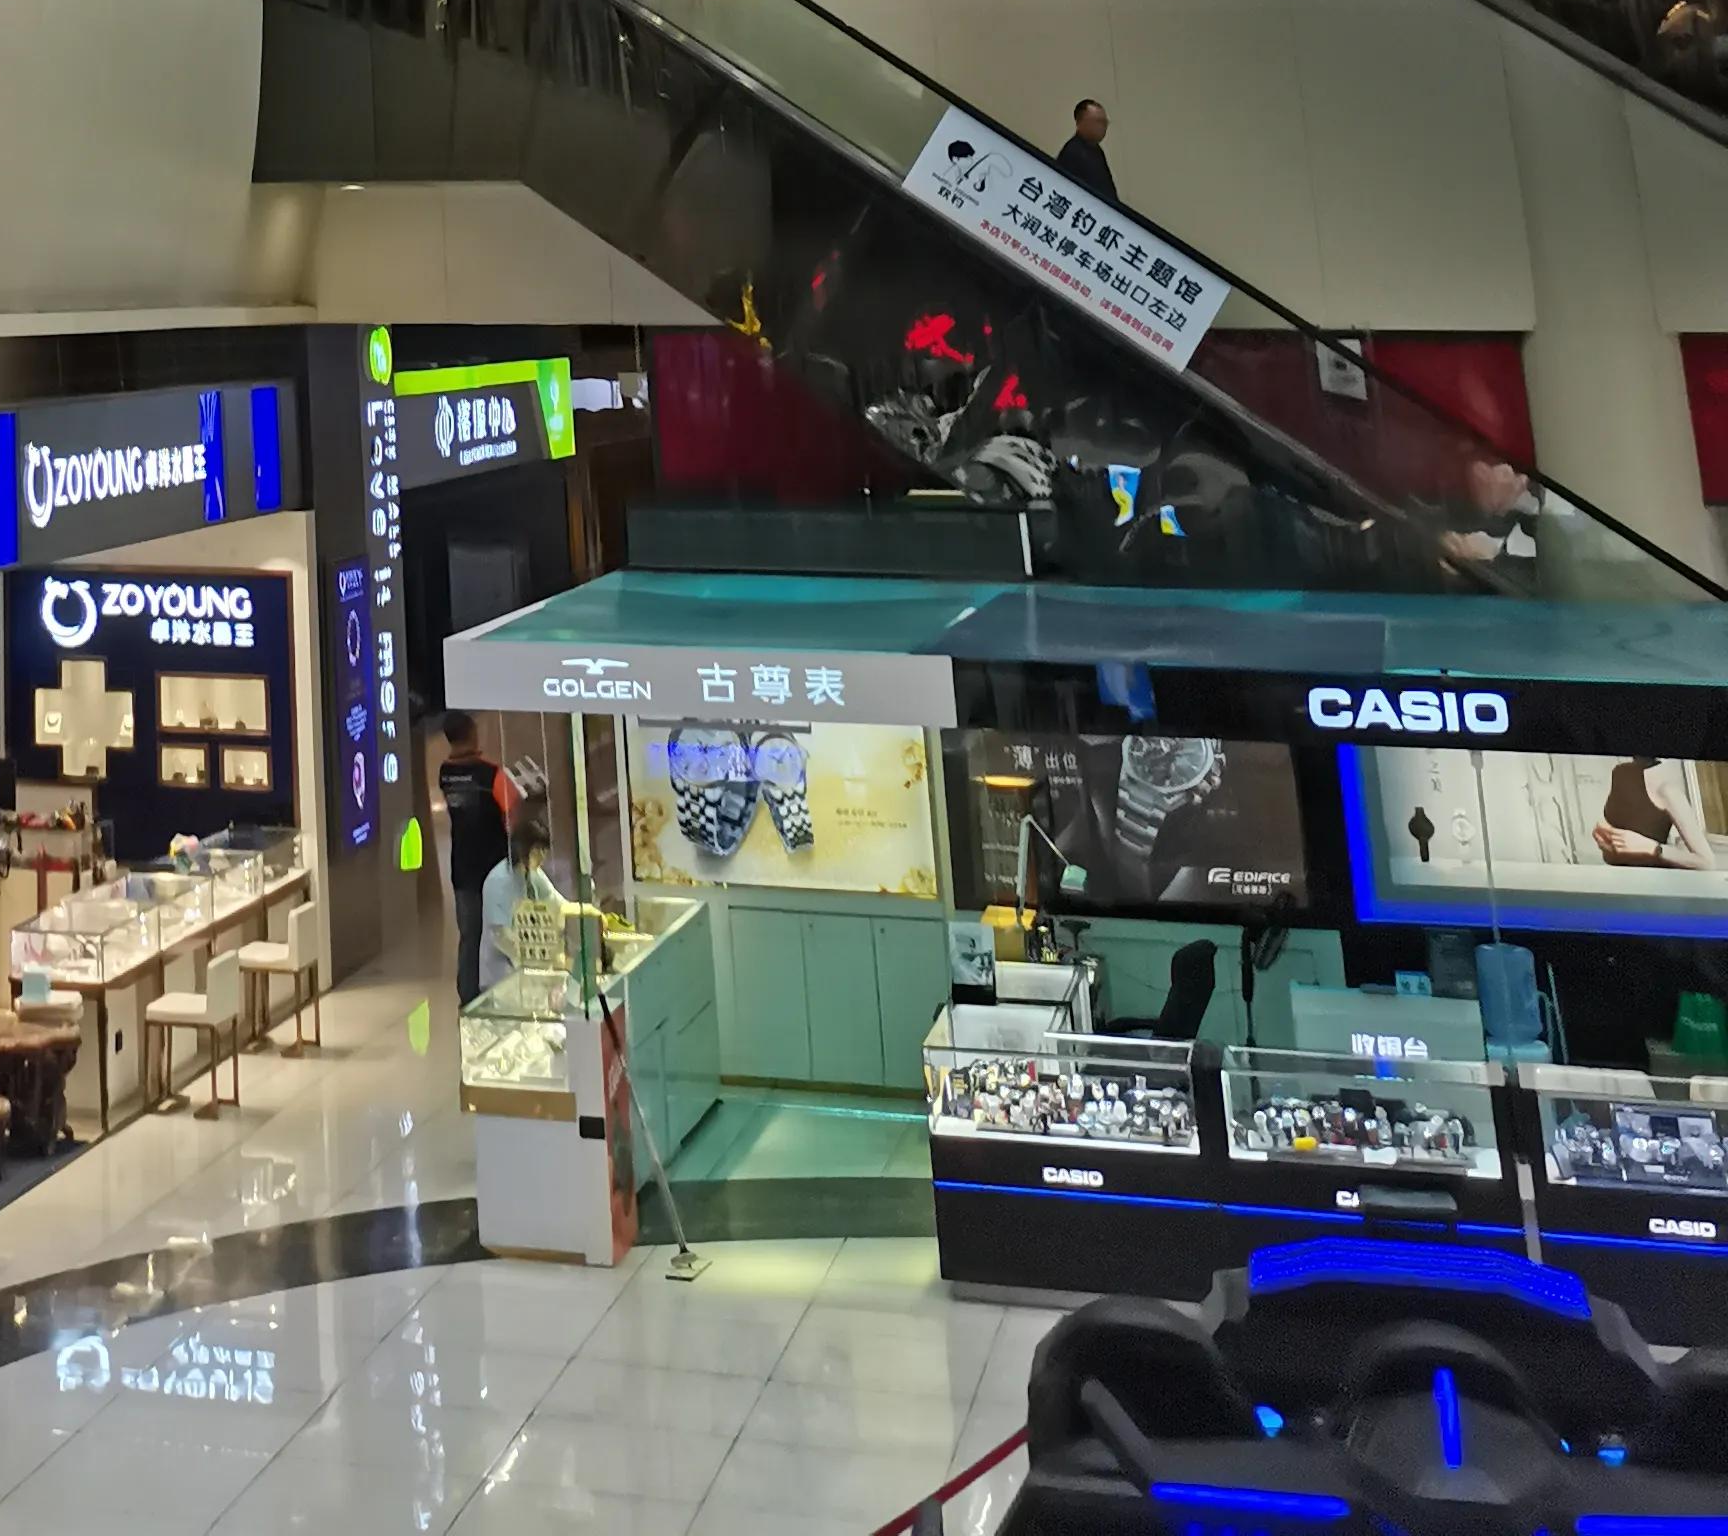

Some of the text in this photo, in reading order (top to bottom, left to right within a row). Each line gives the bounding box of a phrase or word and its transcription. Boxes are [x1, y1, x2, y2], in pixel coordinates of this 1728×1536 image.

[1017, 175, 1204, 306] 台湾钓虾主题馆
[1002, 202, 1188, 333] 大润发停车场出口左边
[53, 445, 143, 508] ZOYOUNG
[101, 581, 253, 621] ZOYOUNG
[543, 661, 846, 707] GOLGEN 古尊表
[1306, 686, 1510, 734] CASIO
[1351, 1033, 1428, 1057] 收银台
[1042, 1166, 1104, 1188] CASIO
[1648, 1217, 1716, 1239] CASIO
